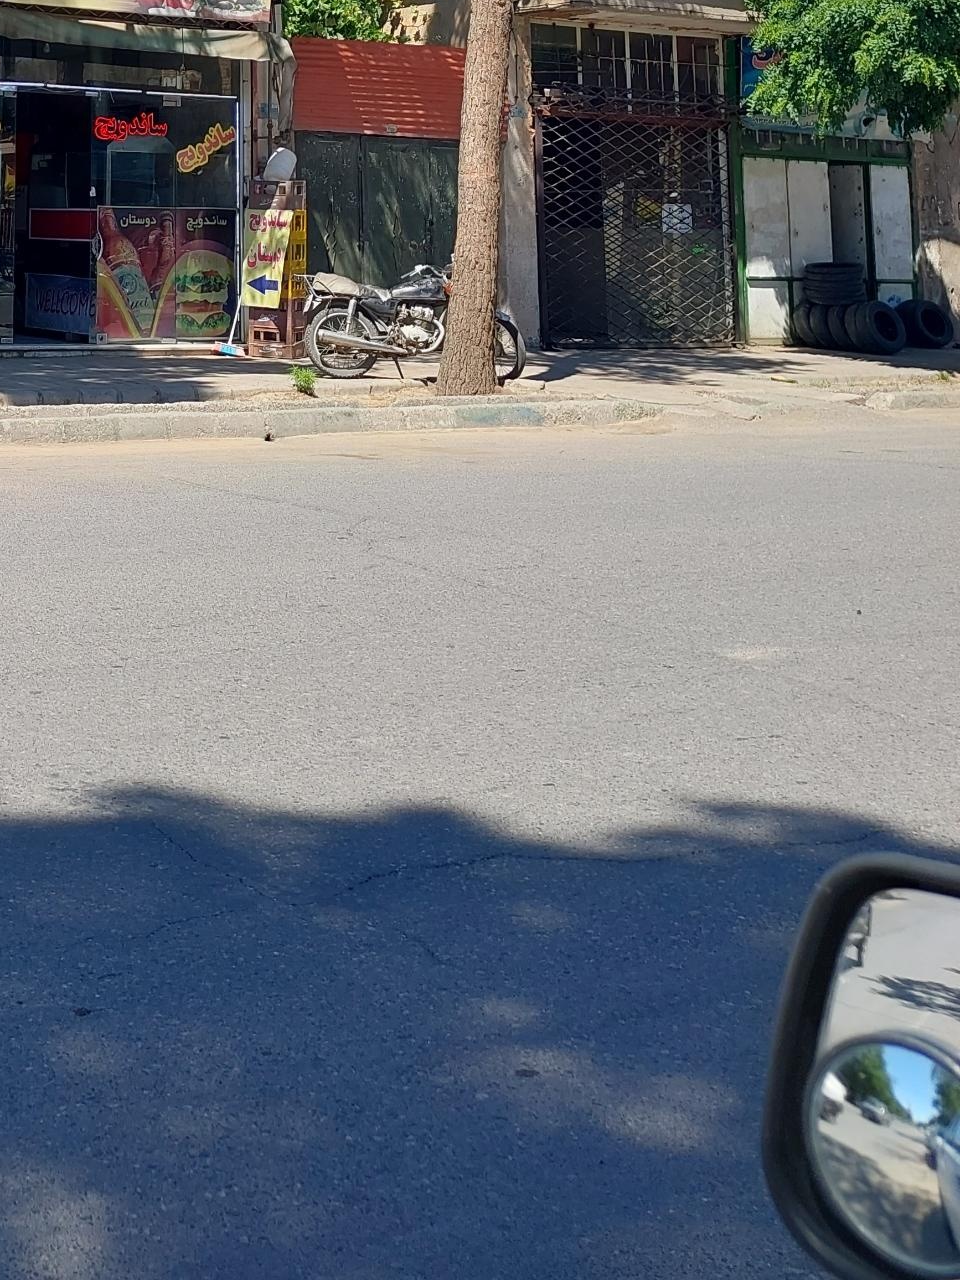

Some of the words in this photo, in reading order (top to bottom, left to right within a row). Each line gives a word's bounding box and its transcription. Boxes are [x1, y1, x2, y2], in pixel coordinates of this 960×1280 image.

[95, 112, 168, 141] ساندویچ
[176, 122, 236, 173] ساندویچ
[120, 214, 157, 227] دوستان
[186, 214, 227, 230] ساندویچ
[249, 211, 287, 232] ساندویچ
[247, 241, 282, 269] دوستان
